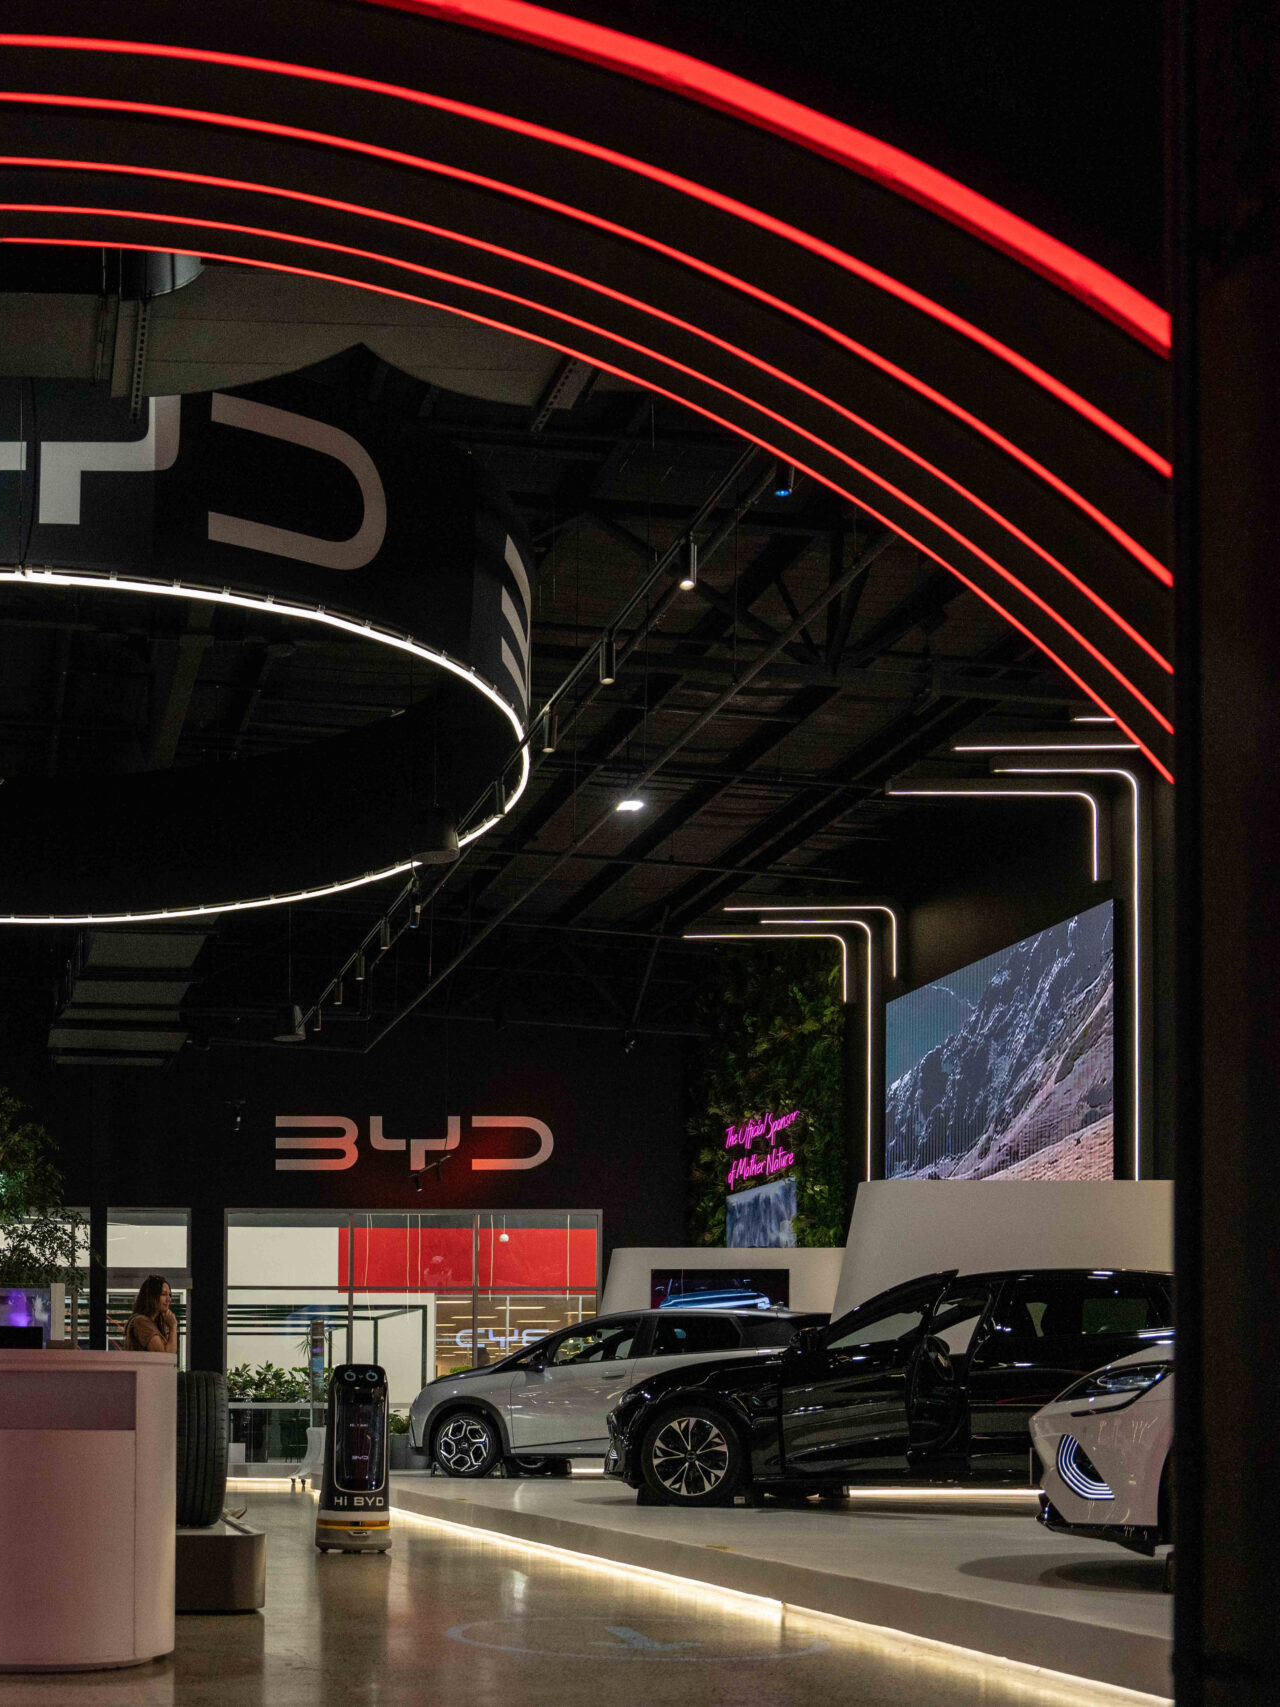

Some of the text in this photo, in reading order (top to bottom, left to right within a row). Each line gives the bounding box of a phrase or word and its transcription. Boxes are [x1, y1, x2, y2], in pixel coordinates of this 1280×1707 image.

[275, 1115, 554, 1170] BYD
[725, 1110, 800, 1149] The Official Sponsor
[727, 1146, 795, 1191] of Mother Nature
[353, 1496, 384, 1506] BYD
